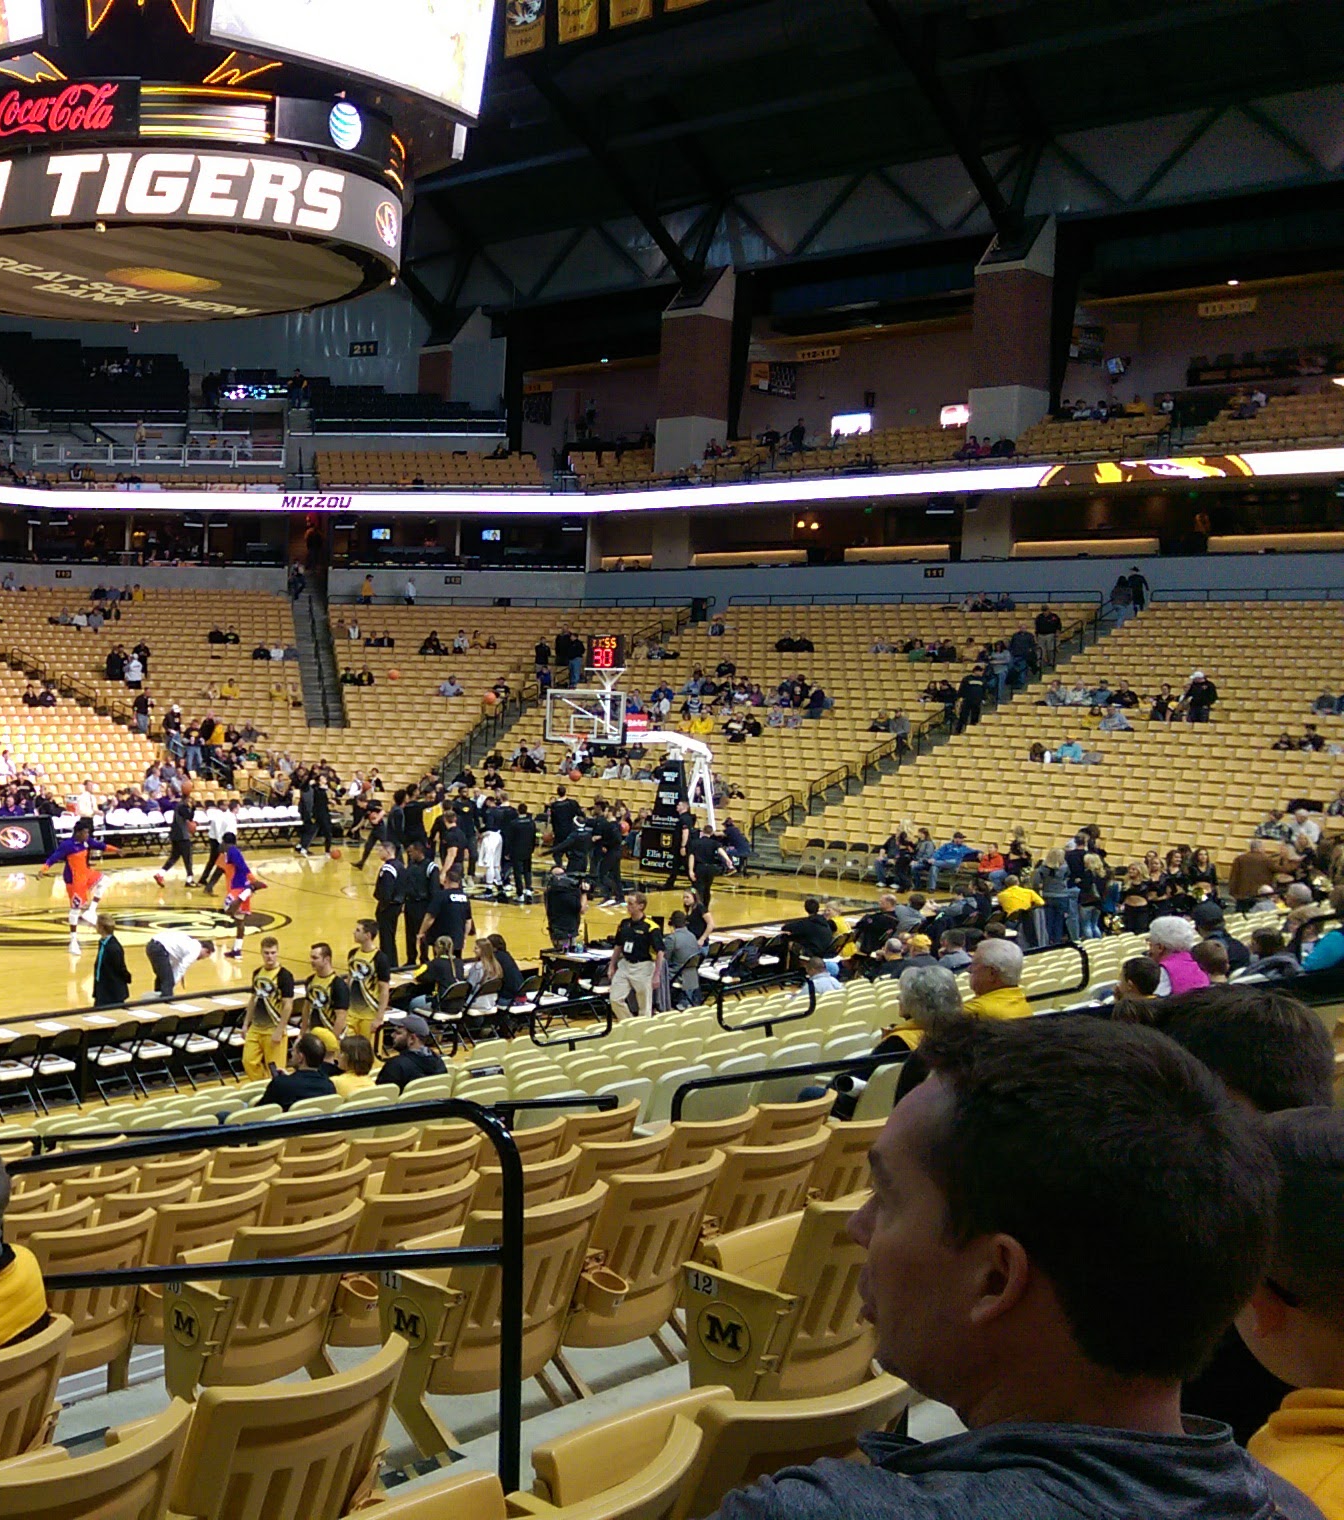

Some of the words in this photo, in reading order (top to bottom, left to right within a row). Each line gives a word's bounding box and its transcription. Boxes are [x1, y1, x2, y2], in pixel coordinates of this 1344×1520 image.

[46, 152, 345, 231] TIGERS
[32, 282, 143, 306] BANK
[79, 282, 261, 315] SOUTHERN
[353, 344, 375, 354] 211
[281, 496, 352, 508] MIZZOU
[594, 649, 612, 666] 30
[641, 858, 664, 867] Cancer
[384, 1271, 398, 1288] 11
[693, 1272, 713, 1295] 12
[174, 1309, 195, 1338] M
[394, 1307, 420, 1338] M
[705, 1311, 743, 1351] M
